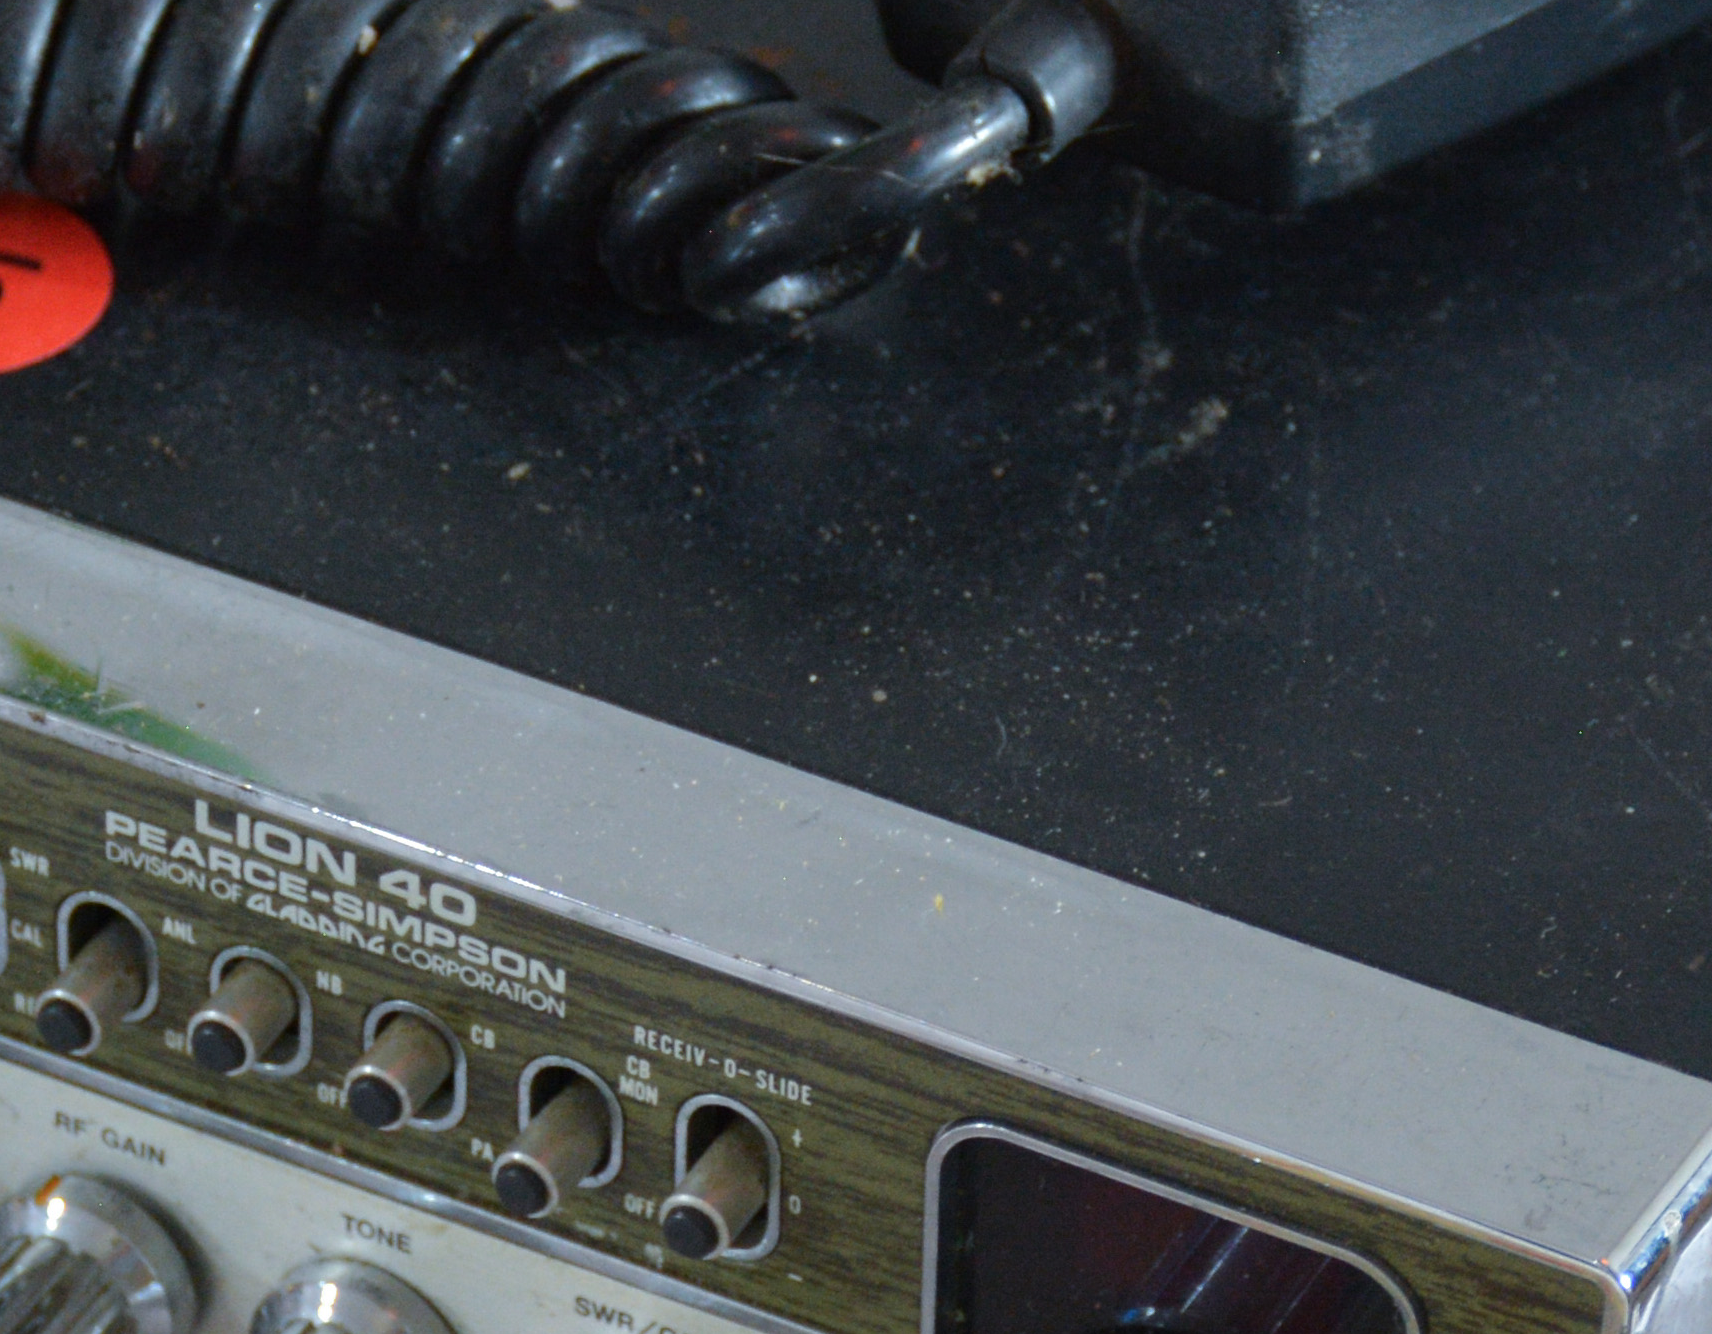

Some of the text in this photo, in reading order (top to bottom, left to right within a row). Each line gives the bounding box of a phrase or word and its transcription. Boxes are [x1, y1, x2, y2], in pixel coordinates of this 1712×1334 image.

[10, 846, 51, 878] SWR
[194, 799, 478, 928] LION 40
[105, 810, 568, 995] PEARCE-SIMPSON
[10, 918, 43, 949] CAL
[104, 839, 567, 1020] DIVISION OF GLADDING CORPORATION
[161, 916, 197, 945] ANL
[316, 970, 343, 996] NB
[470, 1024, 496, 1049] CB
[626, 1054, 652, 1079] CB
[619, 1073, 659, 1107] MON
[53, 1110, 167, 1167] RF GAIN
[470, 1137, 495, 1162] PA
[623, 1192, 656, 1218] OFF
[342, 1212, 414, 1254] TONE
